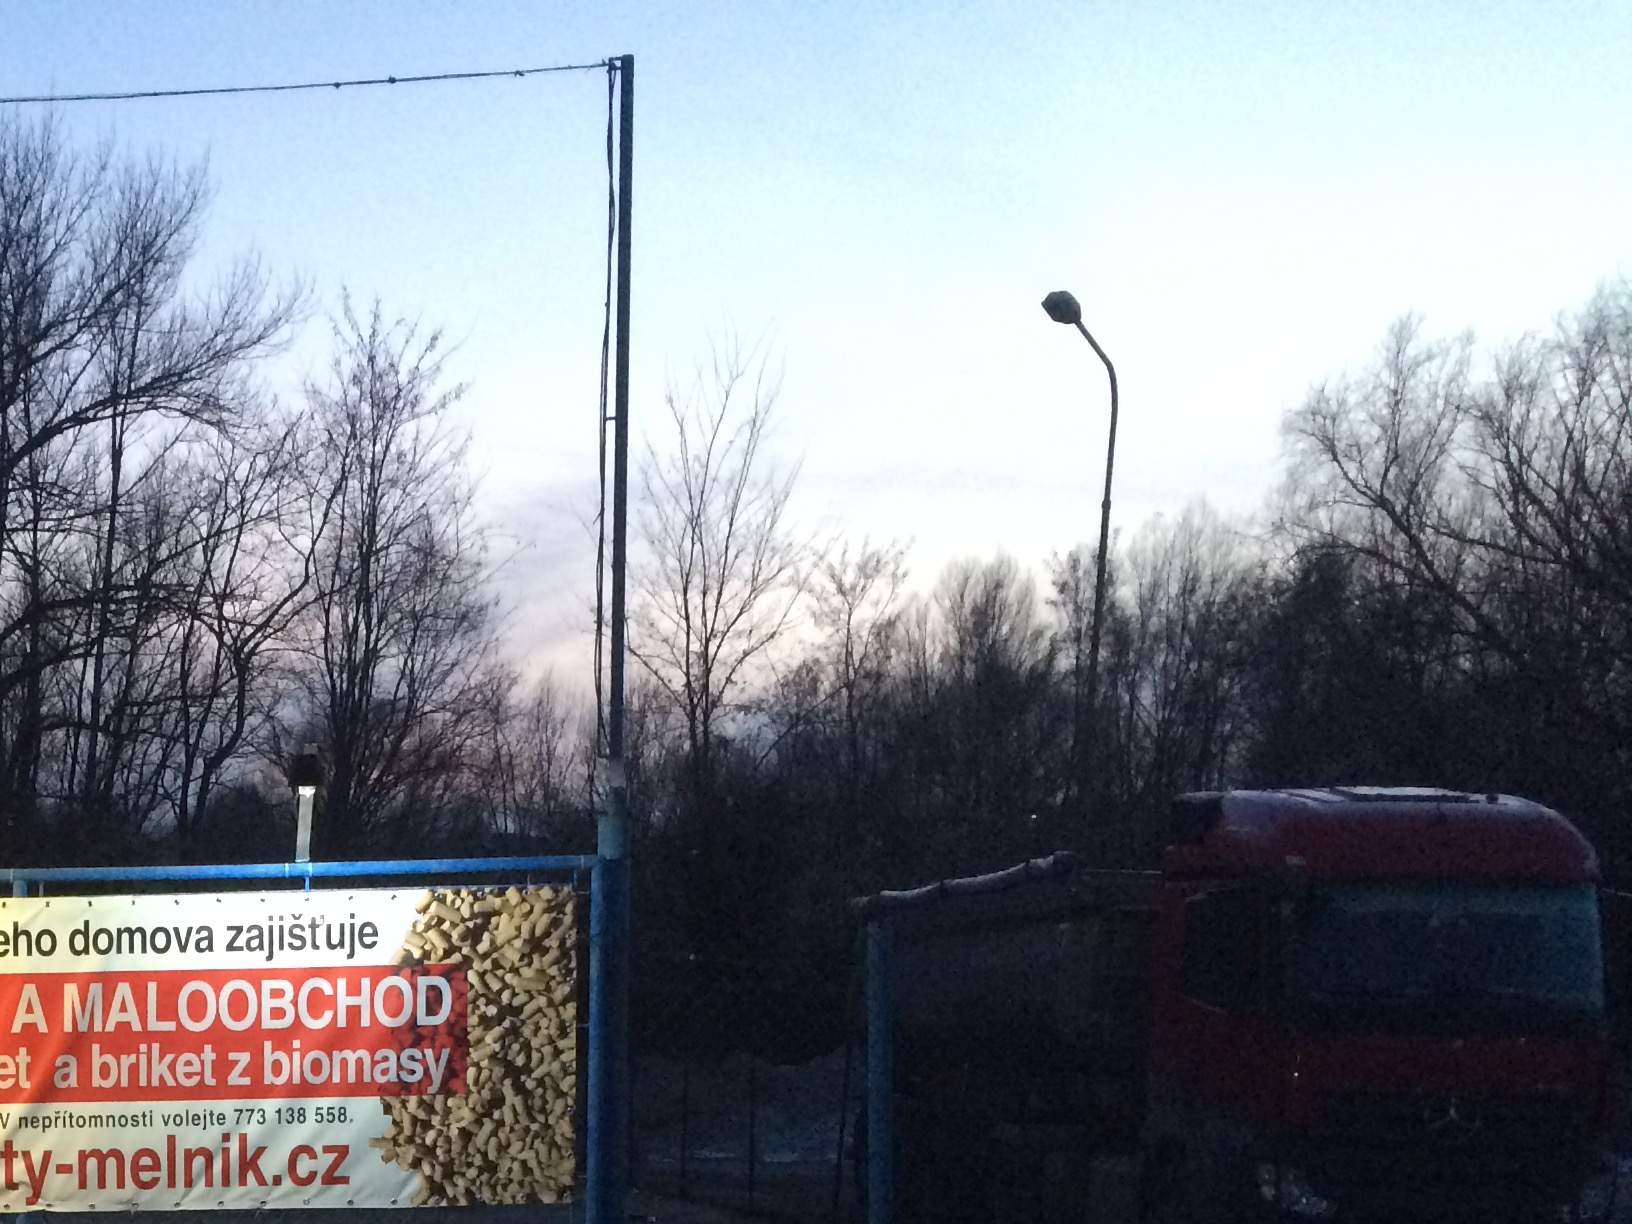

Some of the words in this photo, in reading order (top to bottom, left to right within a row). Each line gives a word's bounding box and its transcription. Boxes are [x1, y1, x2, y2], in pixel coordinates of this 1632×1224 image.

[69, 919, 214, 957] domova
[226, 914, 378, 962] zajišťuje
[11, 983, 48, 1033] A
[63, 976, 451, 1032] MALOOBCHOD
[54, 1054, 78, 1088] a
[92, 1043, 216, 1088] briket
[228, 1053, 251, 1085] z
[263, 1041, 450, 1093] biomasy
[0, 1114, 10, 1129] V
[18, 1109, 153, 1133] nepřítomnosti
[162, 1108, 226, 1130] volejte
[234, 1109, 266, 1125] 773
[275, 1107, 306, 1125] 138
[314, 1107, 354, 1124] 558.
